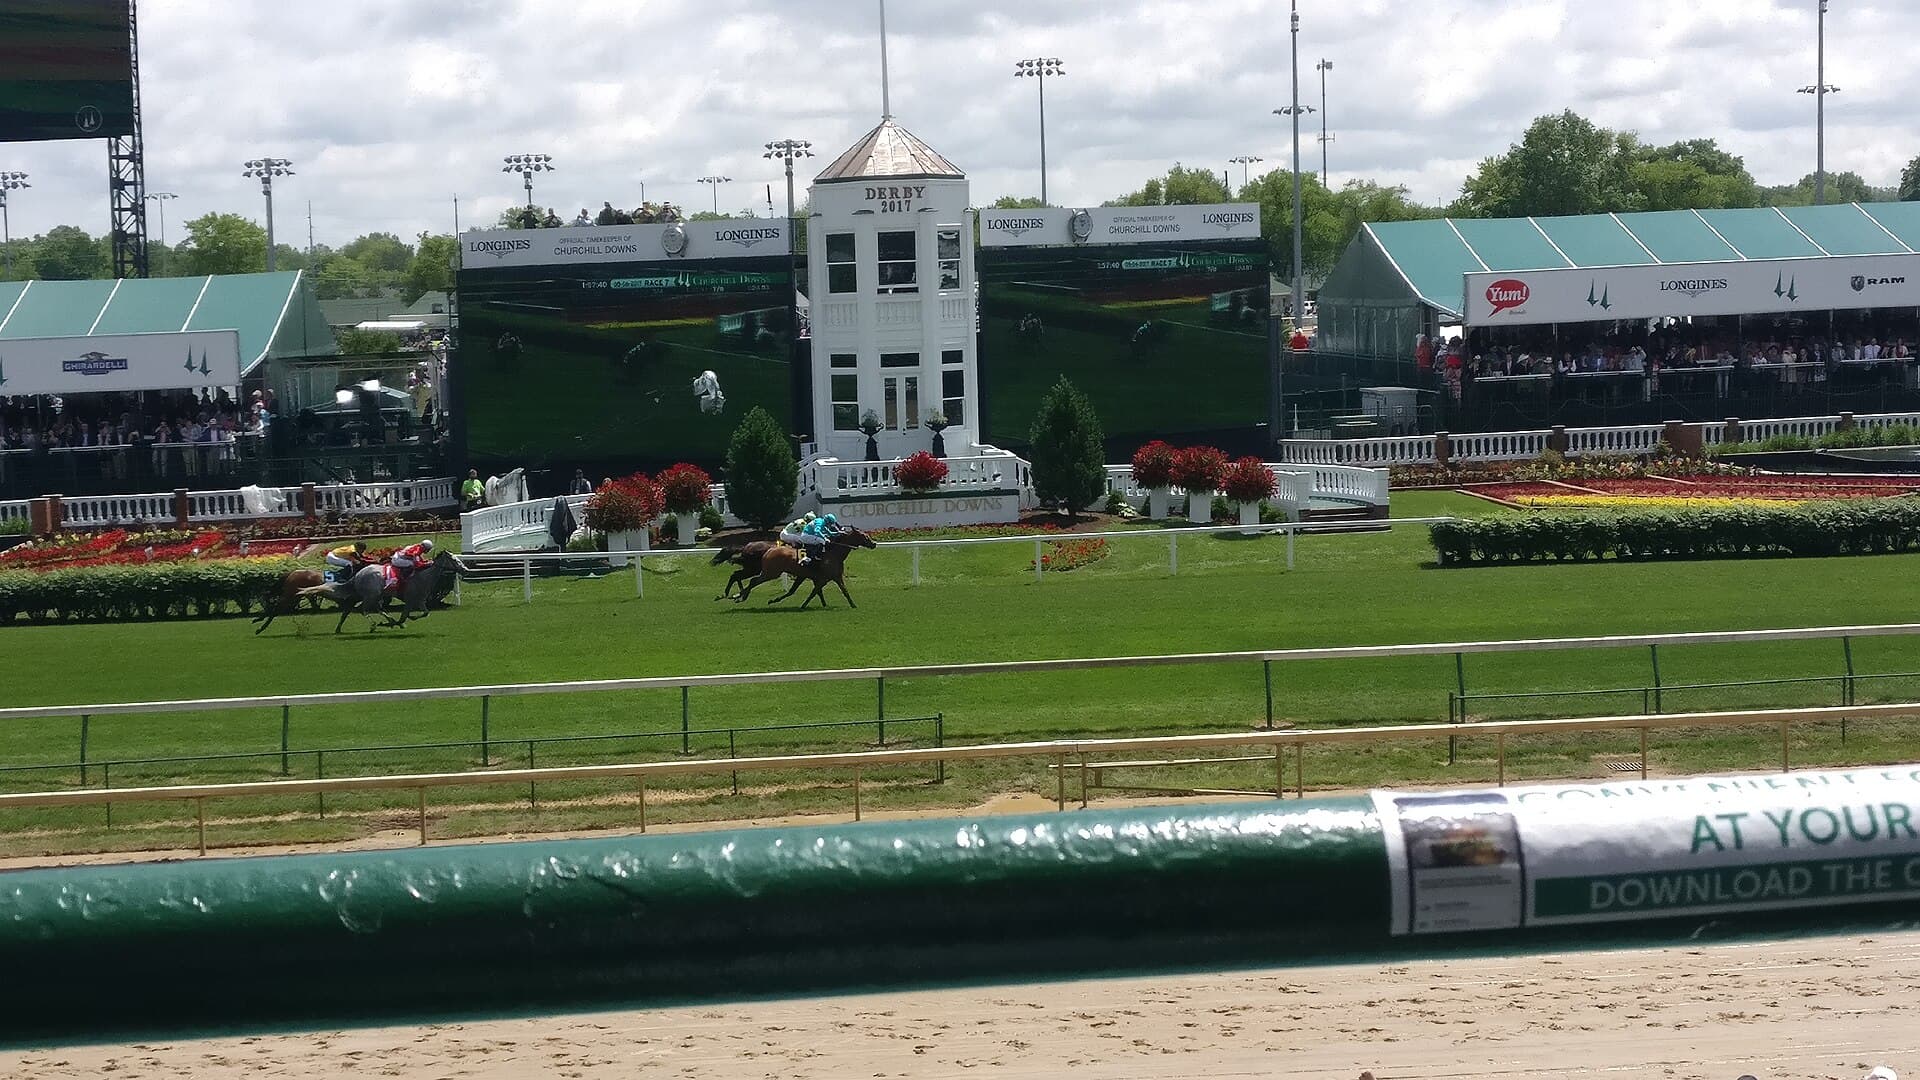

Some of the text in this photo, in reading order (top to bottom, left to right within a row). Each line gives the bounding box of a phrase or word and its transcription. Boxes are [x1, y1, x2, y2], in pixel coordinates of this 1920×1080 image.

[865, 186, 926, 200] DERBY
[881, 200, 911, 213] 2017
[987, 218, 1044, 230] LONGINES
[1202, 212, 1254, 224] LONGINES
[715, 228, 779, 241] LONGINES
[1109, 223, 1181, 234] CHURCHILL DOWNS
[470, 239, 531, 252] LONGINES
[554, 244, 637, 256] CHURCHILL DOWNS
[1660, 278, 1728, 291] LONGINES
[1867, 277, 1905, 285] RAM
[1489, 285, 1527, 302] Yum!
[64, 361, 126, 370] GHIRARDELLI
[839, 497, 1003, 519] CHURCHILL DOWNS
[324, 570, 335, 582] 5
[1690, 803, 1918, 854] AT YOUR
[1590, 867, 1813, 909] DOWNLOAD
[1822, 860, 1892, 892] THE
